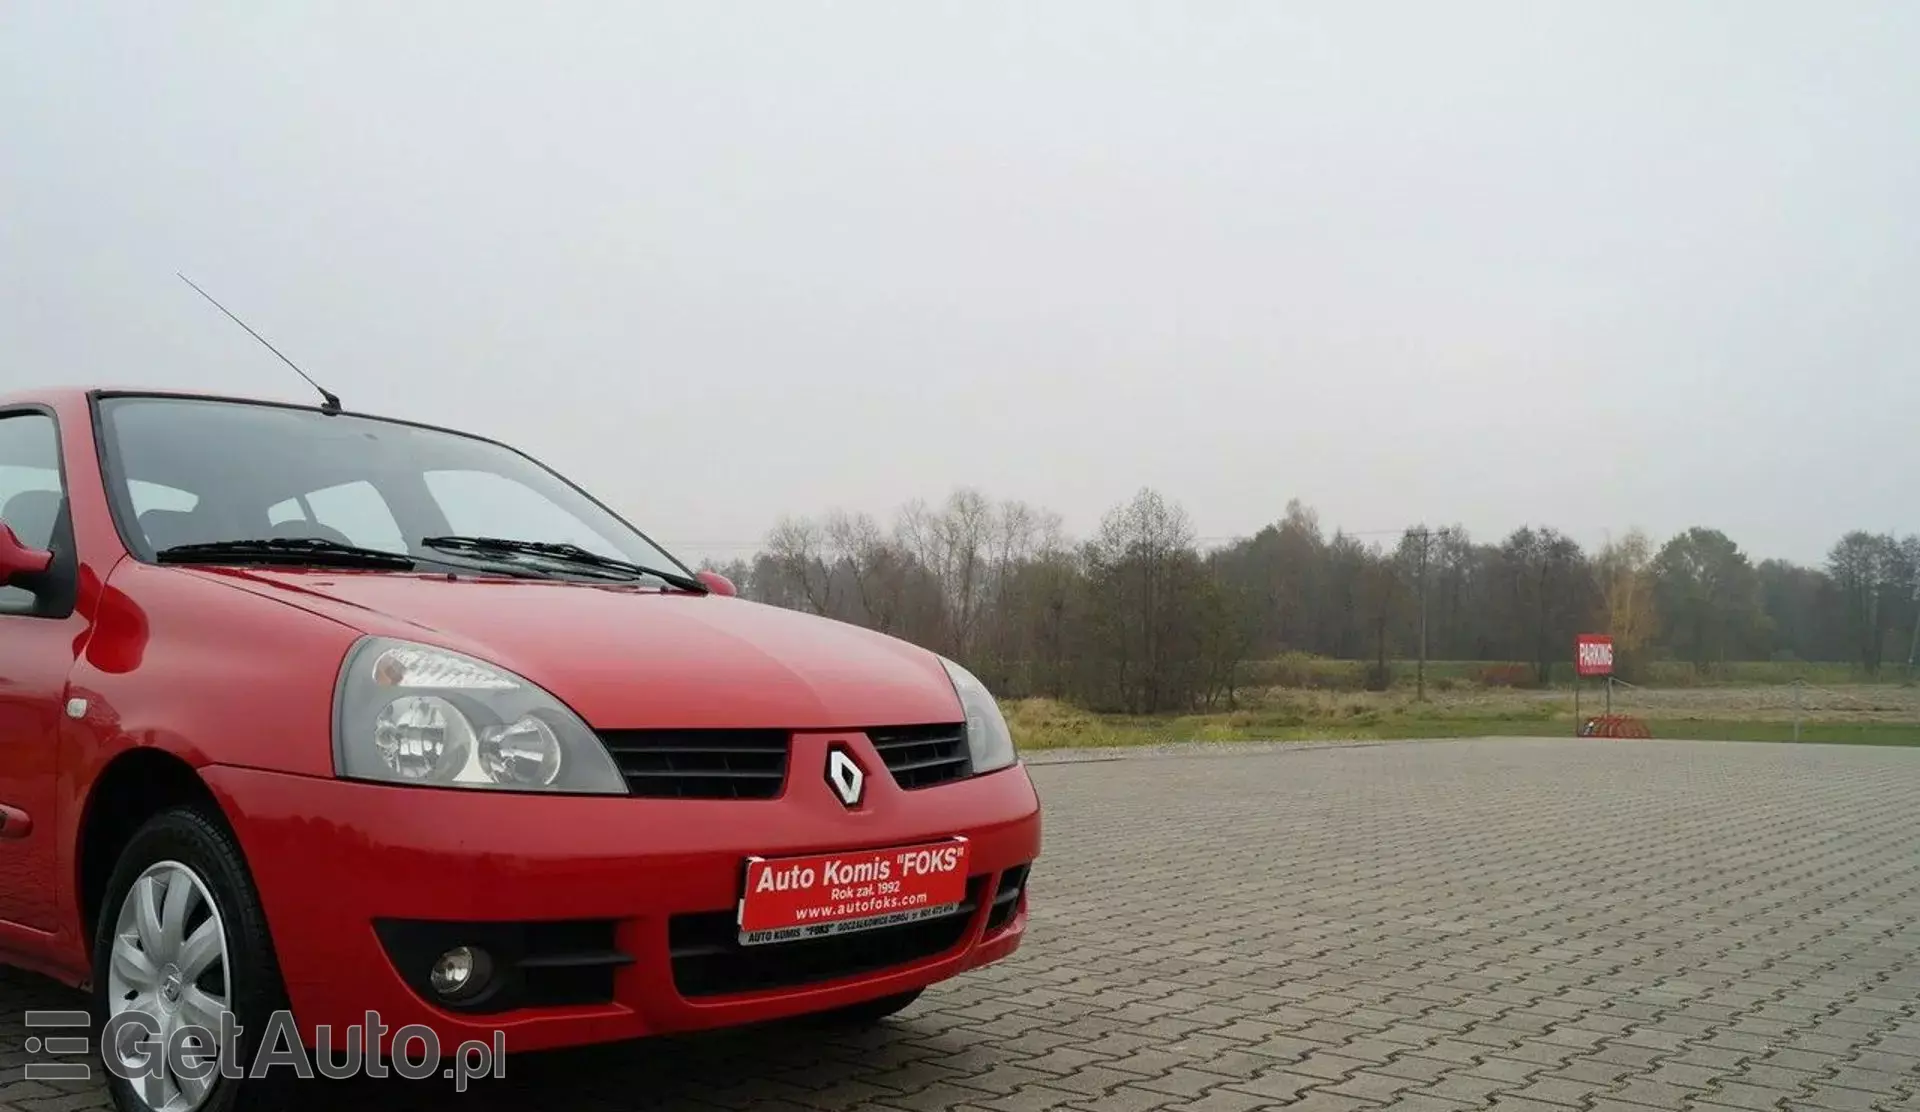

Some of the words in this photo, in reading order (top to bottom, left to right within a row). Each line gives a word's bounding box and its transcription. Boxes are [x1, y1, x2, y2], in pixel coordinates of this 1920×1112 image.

[1580, 643, 1613, 666] PARKING
[756, 864, 814, 893] Auto
[823, 857, 890, 886] Komis
[896, 846, 964, 877] "FOKS"
[831, 886, 854, 900] Rok
[877, 881, 900, 895] 1992
[795, 892, 927, 920] www.autofoks.com
[748, 930, 772, 943] AUTO
[774, 928, 801, 940] KOMIS
